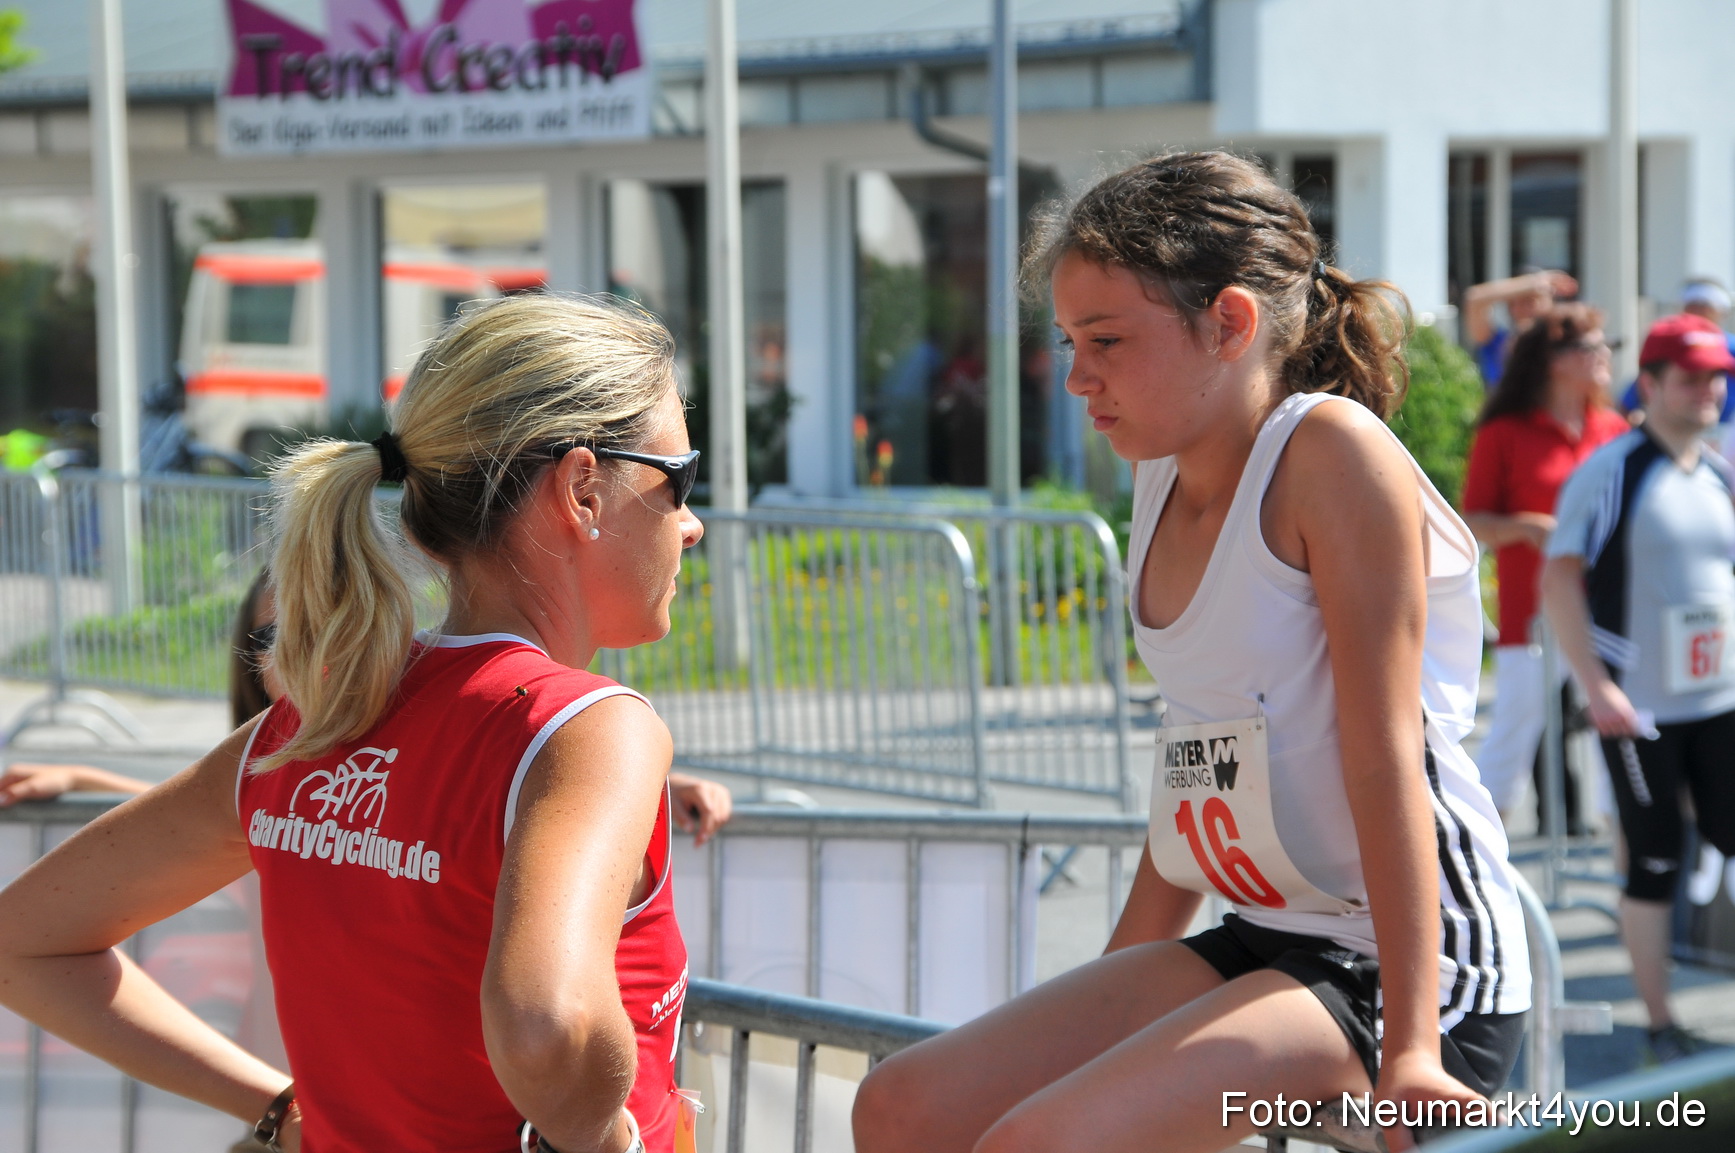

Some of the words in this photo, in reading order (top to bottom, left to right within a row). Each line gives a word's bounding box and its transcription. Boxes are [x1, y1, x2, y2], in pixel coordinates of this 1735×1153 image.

[241, 25, 399, 101] Trend
[420, 15, 625, 94] Creativ
[1164, 769, 1212, 788] WERBUNG
[1165, 740, 1208, 768] MEYER
[249, 808, 441, 884] CharityCycling.de
[1175, 797, 1287, 909] 16
